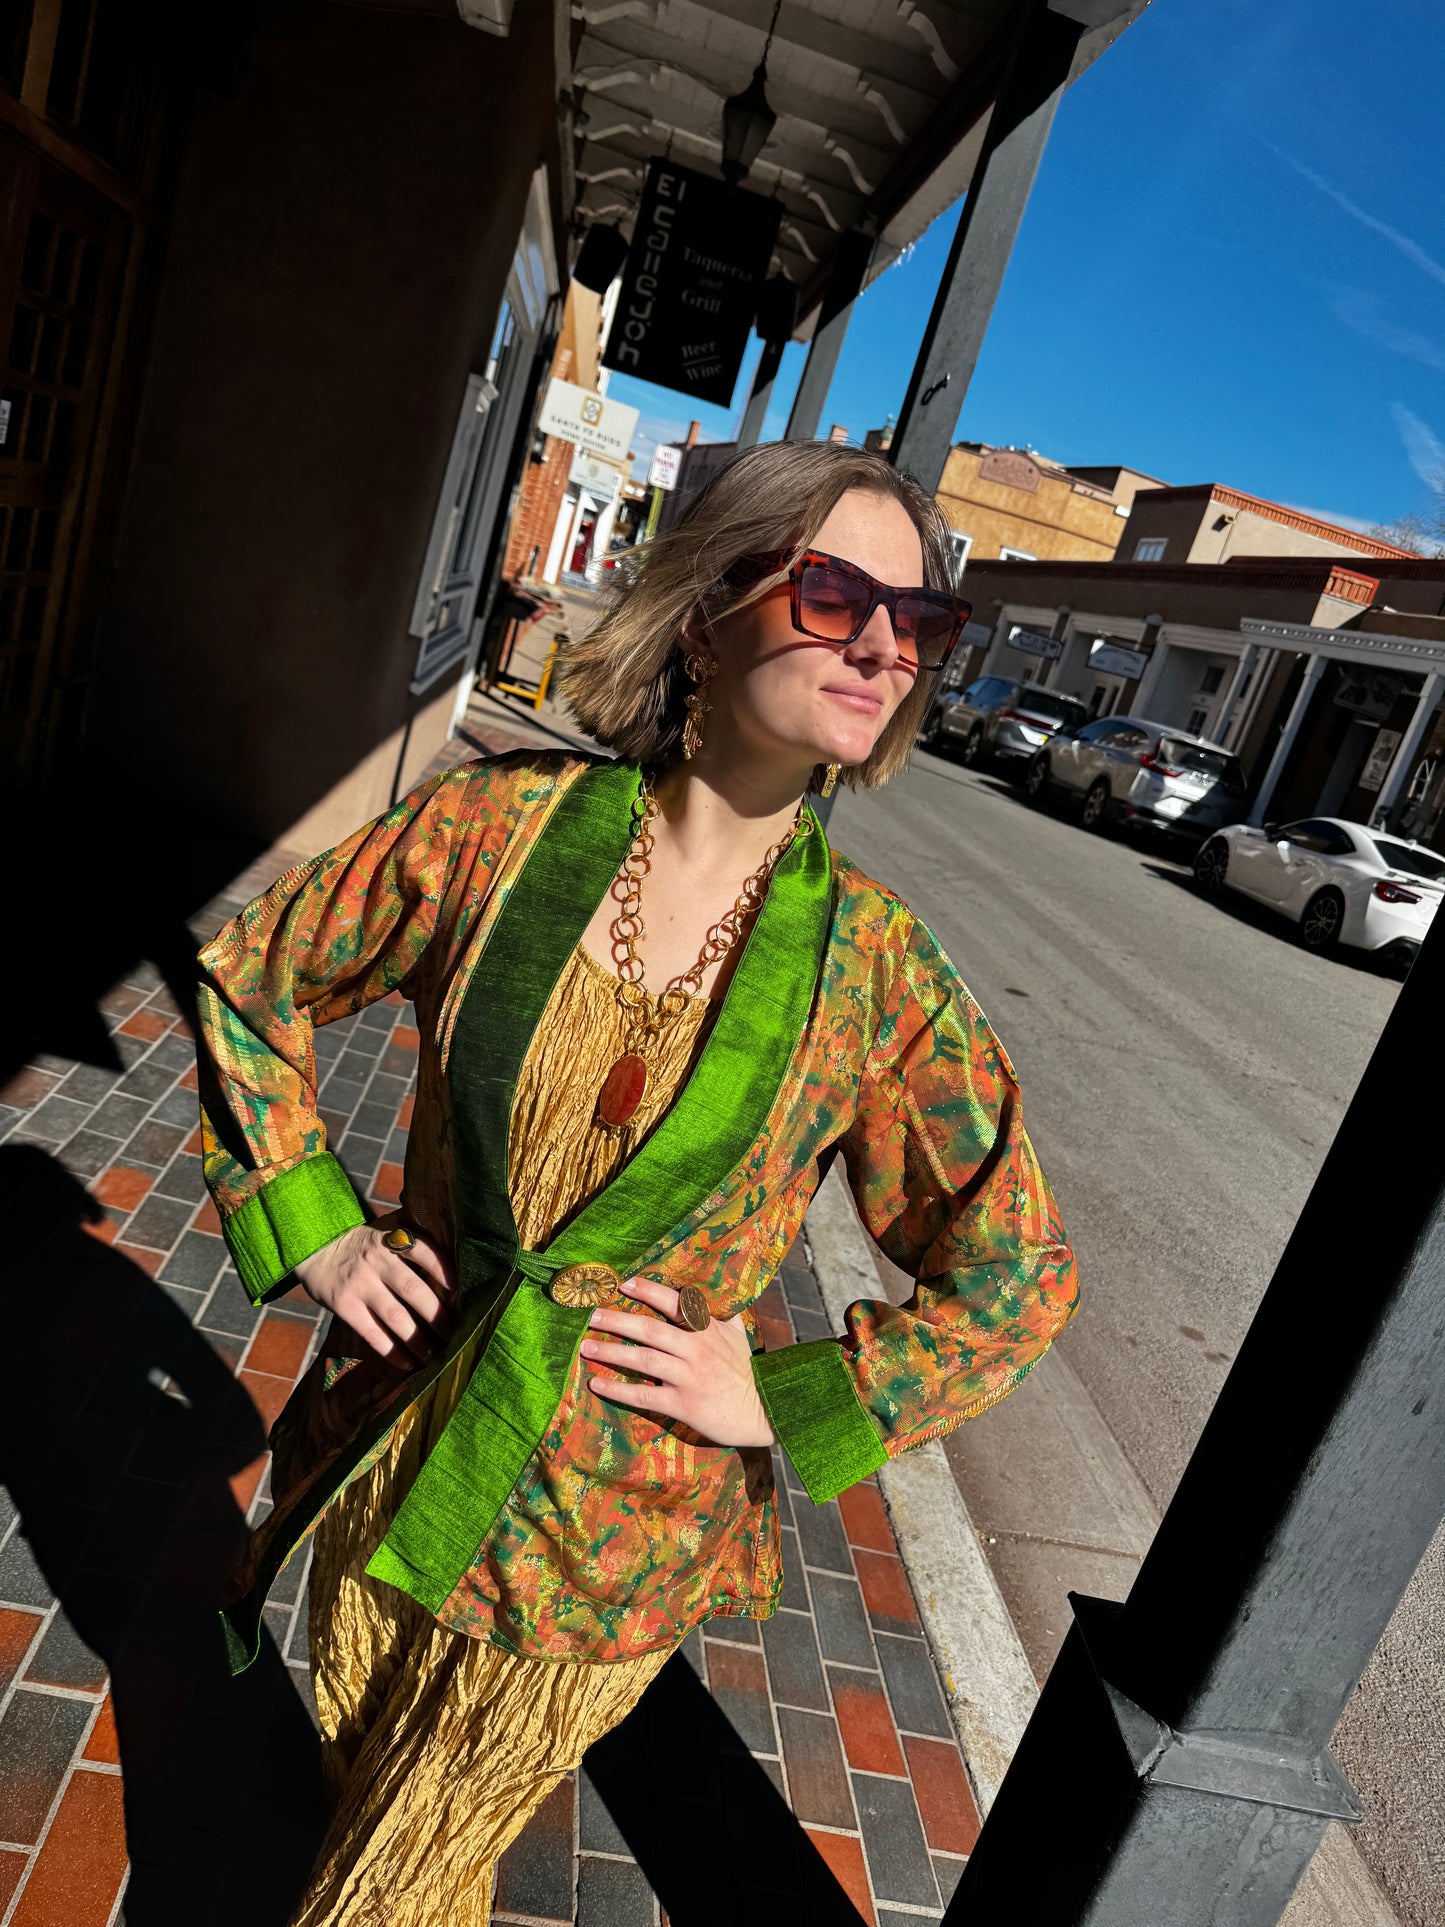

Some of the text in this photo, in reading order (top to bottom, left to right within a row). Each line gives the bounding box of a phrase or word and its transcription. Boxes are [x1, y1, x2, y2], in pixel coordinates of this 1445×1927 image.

[656, 172, 687, 203] El
[682, 245, 753, 283] Taqueria
[698, 277, 724, 292] and
[681, 289, 722, 315] Grill
[681, 340, 718, 359] Beer
[686, 362, 724, 381] Wine
